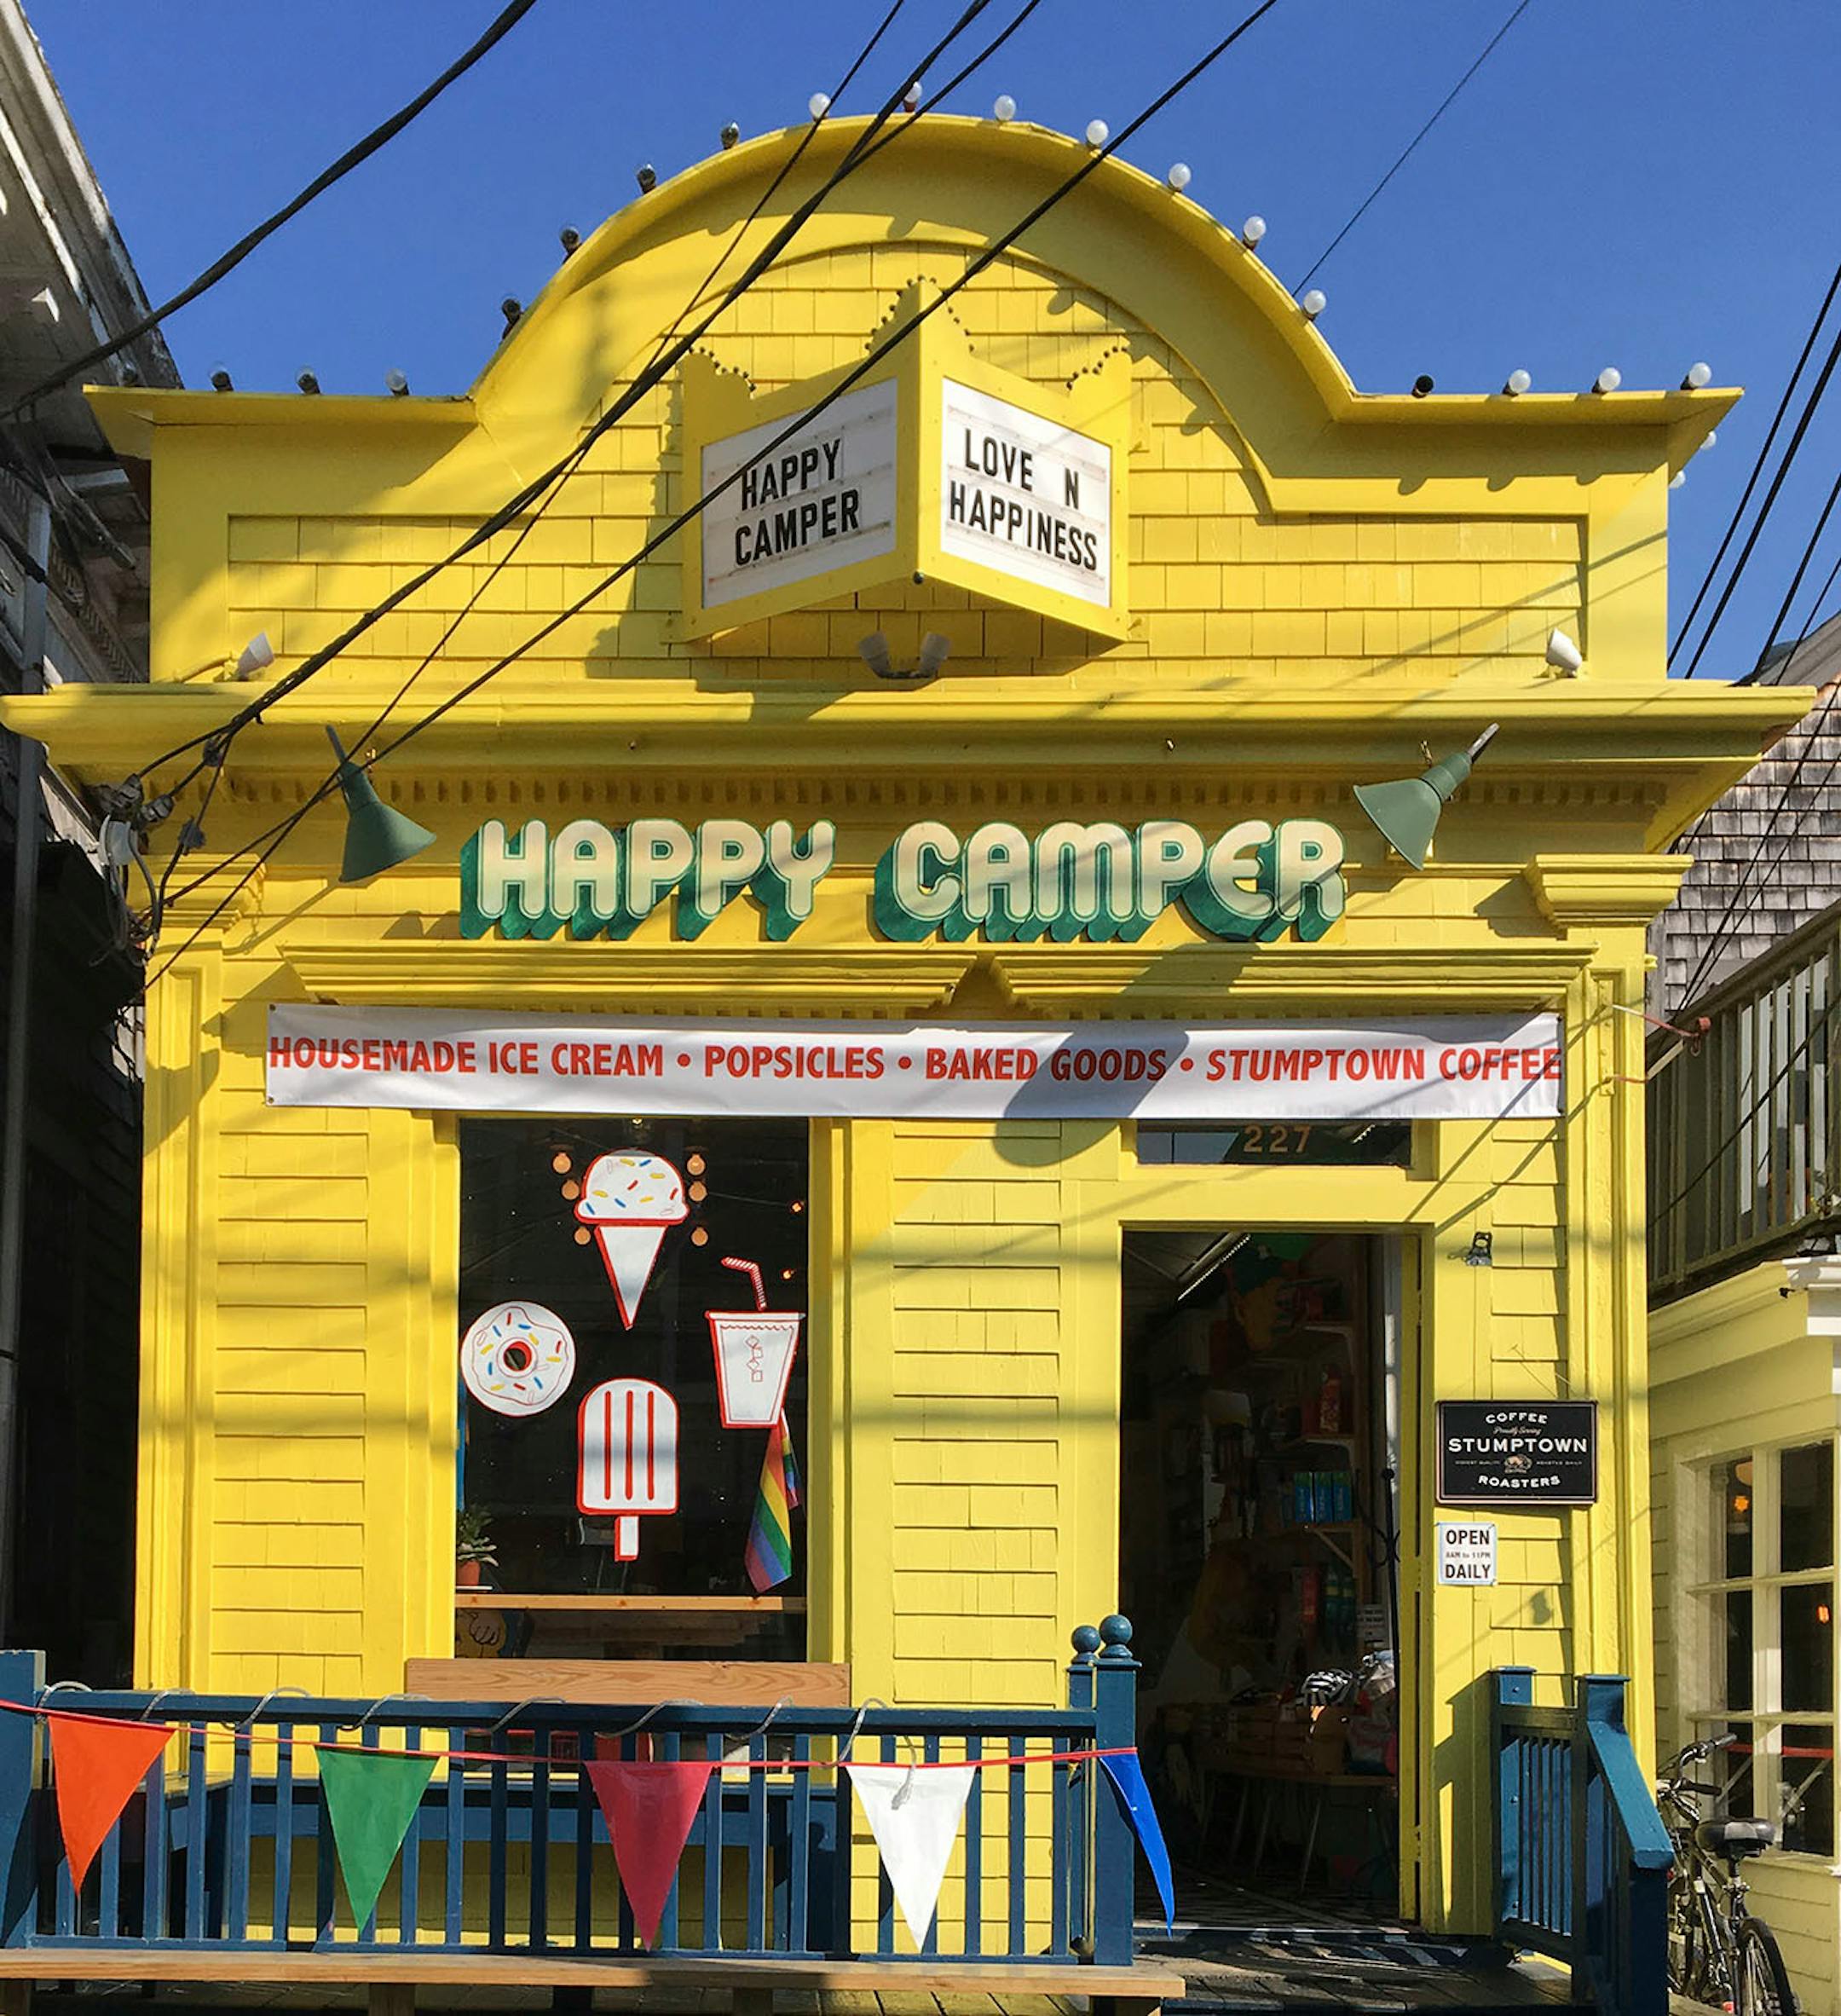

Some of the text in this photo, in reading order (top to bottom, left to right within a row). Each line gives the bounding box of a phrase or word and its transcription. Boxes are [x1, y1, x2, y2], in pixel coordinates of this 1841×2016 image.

[741, 438, 842, 511] HAPPY
[964, 428, 1080, 511] LOVE N
[735, 488, 860, 567] CAMPER
[949, 479, 1098, 572] HAPPINESS
[463, 818, 1347, 941] HAPPY CAMPER
[269, 1037, 1562, 1082] HOUSEMADE ICE CREAM POPSICLES BAKED GOODS STUMPTOWN COFFEE
[1243, 1124, 1312, 1153] 227
[1485, 1412, 1548, 1424] COFFEE
[1448, 1438, 1588, 1453] STUMPTOWN
[1478, 1475, 1561, 1488] ROASTERS
[1446, 1529, 1490, 1545] OPEN
[1446, 1563, 1491, 1579] DAILY
